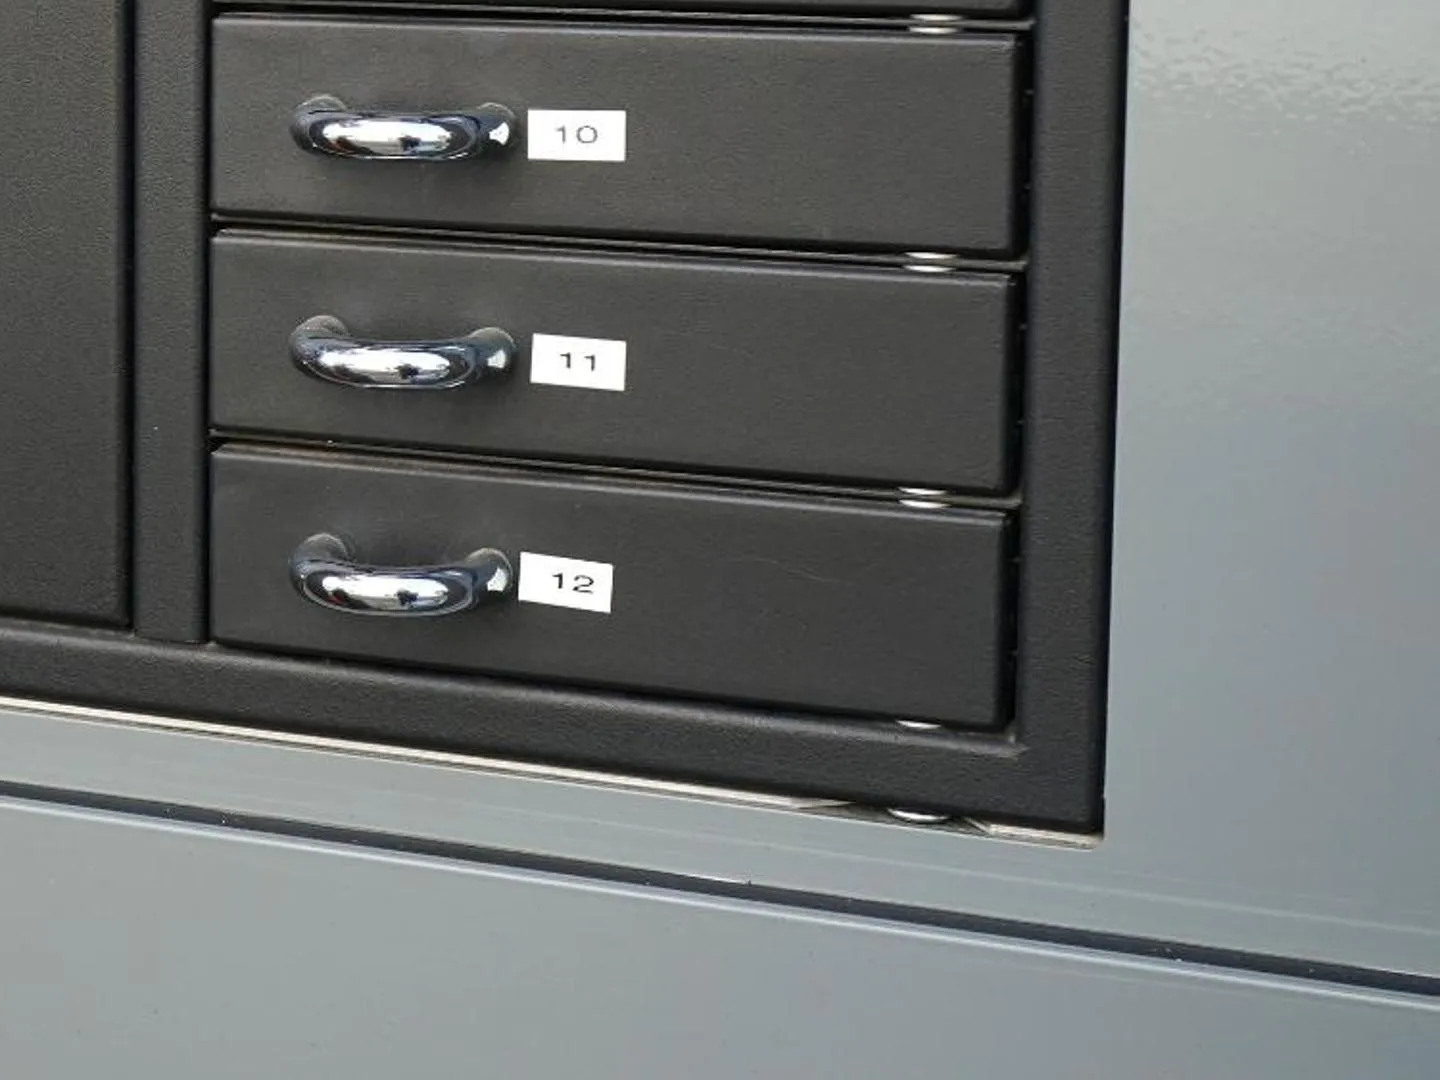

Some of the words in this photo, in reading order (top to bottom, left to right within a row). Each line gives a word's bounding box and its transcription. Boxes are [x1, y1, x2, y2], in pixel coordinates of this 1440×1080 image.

[556, 125, 598, 145] 10
[559, 352, 597, 372] 11
[552, 572, 594, 594] 12
